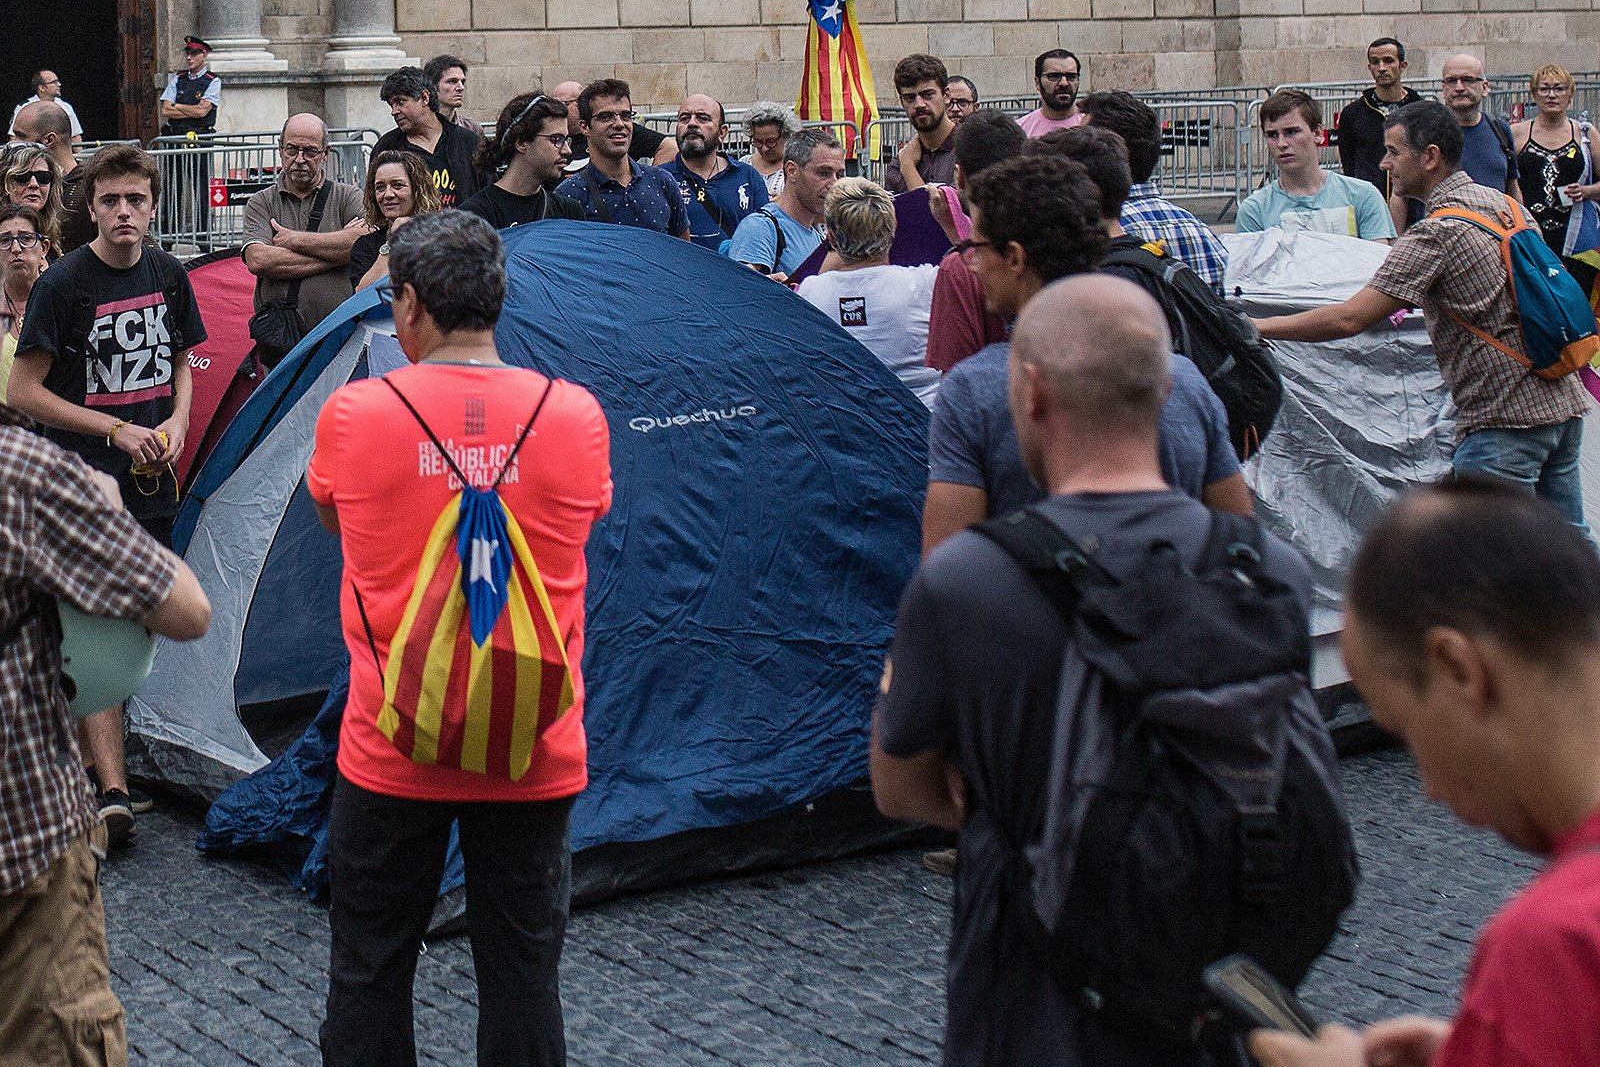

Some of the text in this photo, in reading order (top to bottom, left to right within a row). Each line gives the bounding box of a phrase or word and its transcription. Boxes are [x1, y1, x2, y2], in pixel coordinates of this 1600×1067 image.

[87, 303, 171, 352] FCK
[86, 344, 172, 394] NZS
[628, 405, 758, 433] Quechua
